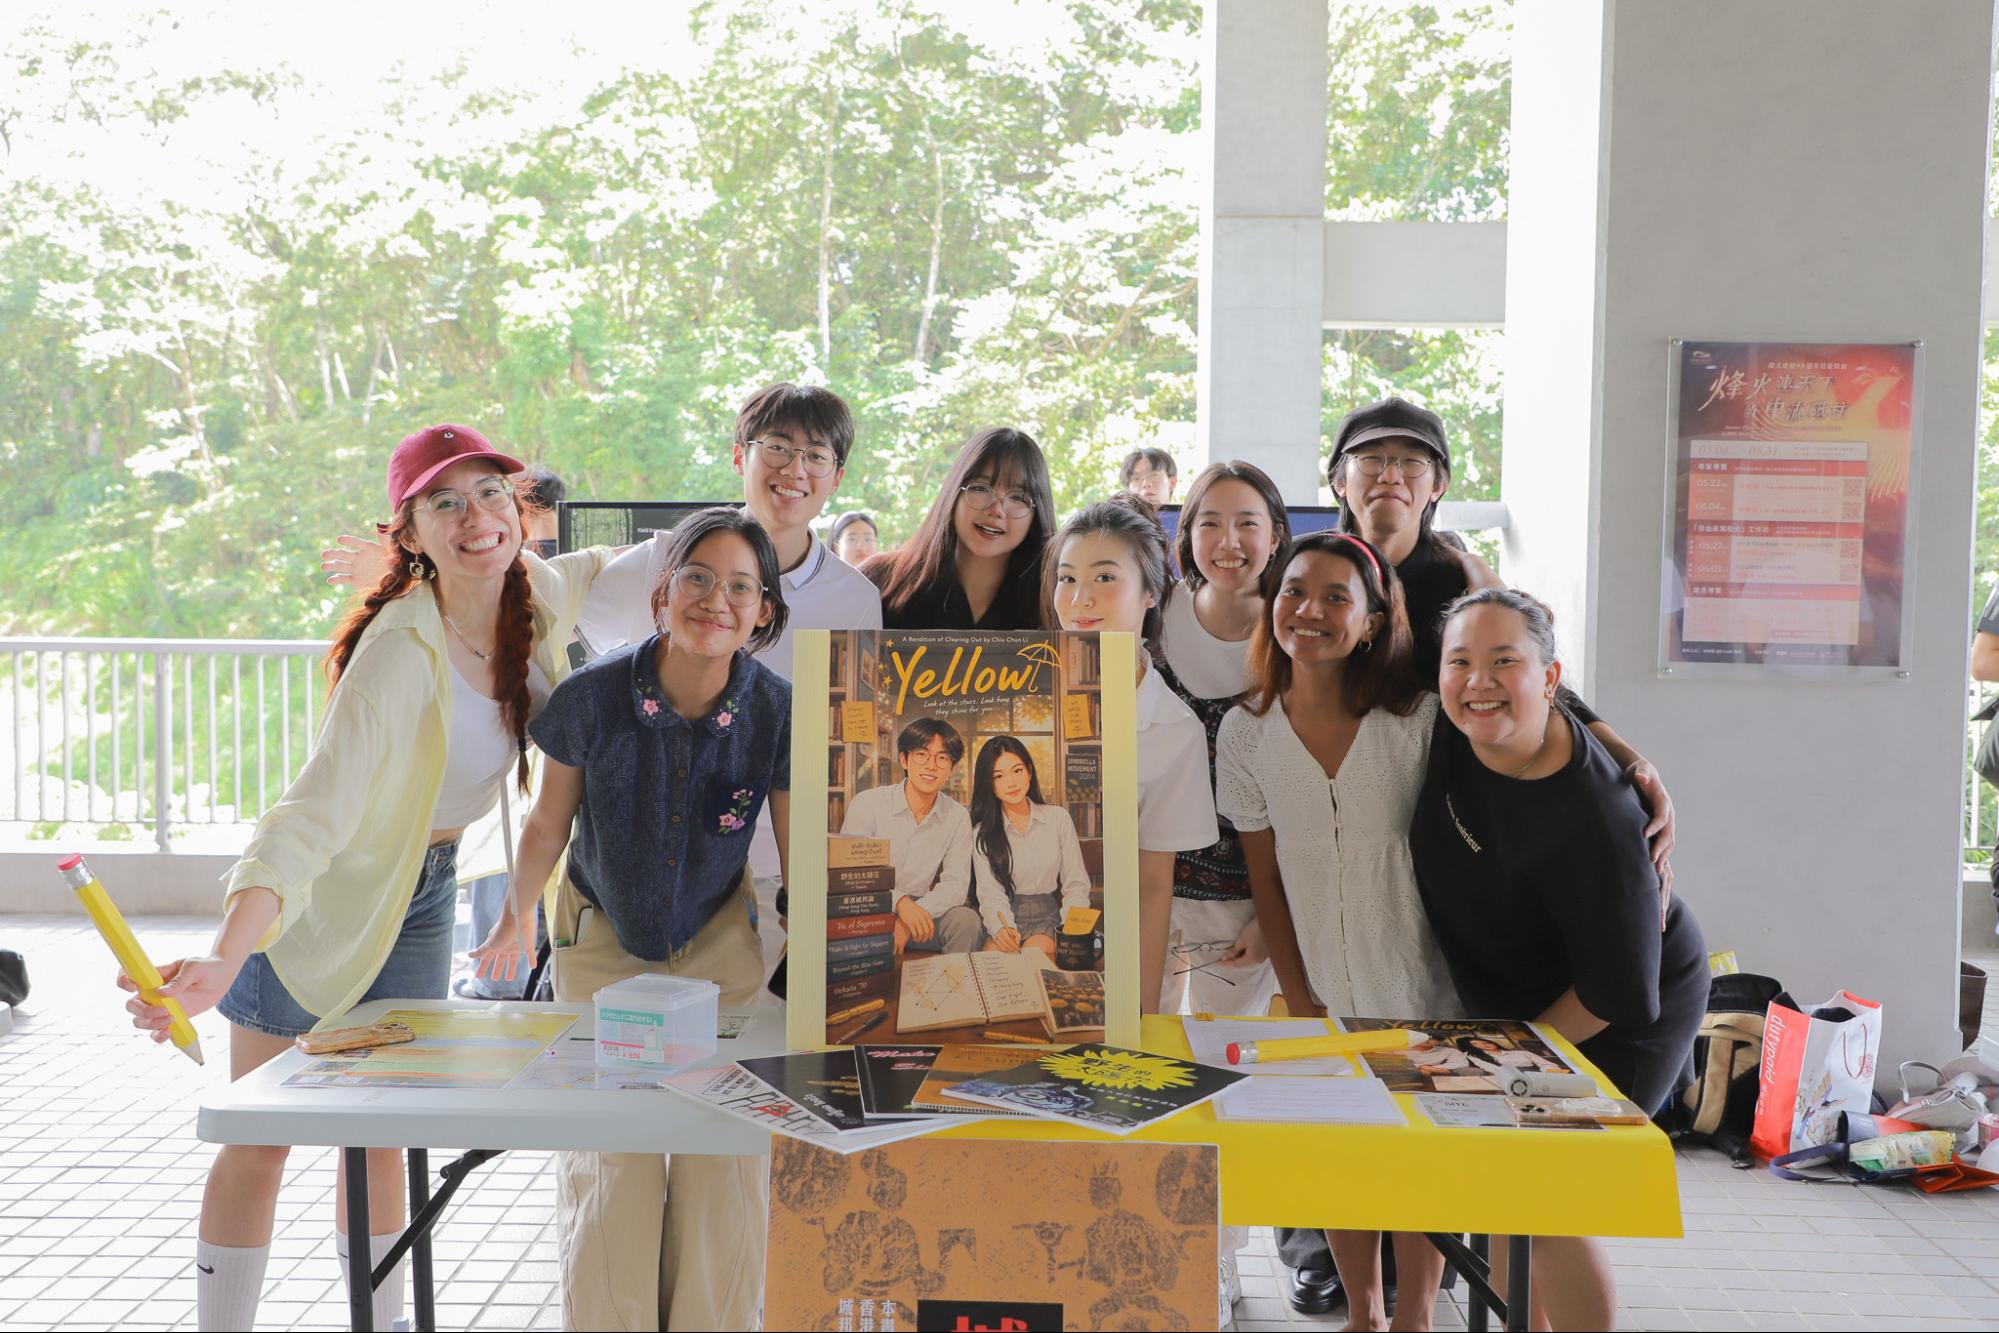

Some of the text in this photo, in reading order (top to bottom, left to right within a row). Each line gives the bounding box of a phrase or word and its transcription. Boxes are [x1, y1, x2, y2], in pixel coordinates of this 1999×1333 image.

[944, 636, 969, 644] Clearing
[983, 636, 991, 644] by
[891, 645, 1033, 716] Yellow
[948, 699, 958, 707] the
[1068, 765, 1097, 773] MOVEMENT
[1383, 1019, 1478, 1031] Yellow
[1764, 1013, 1787, 1085] dutypaid
